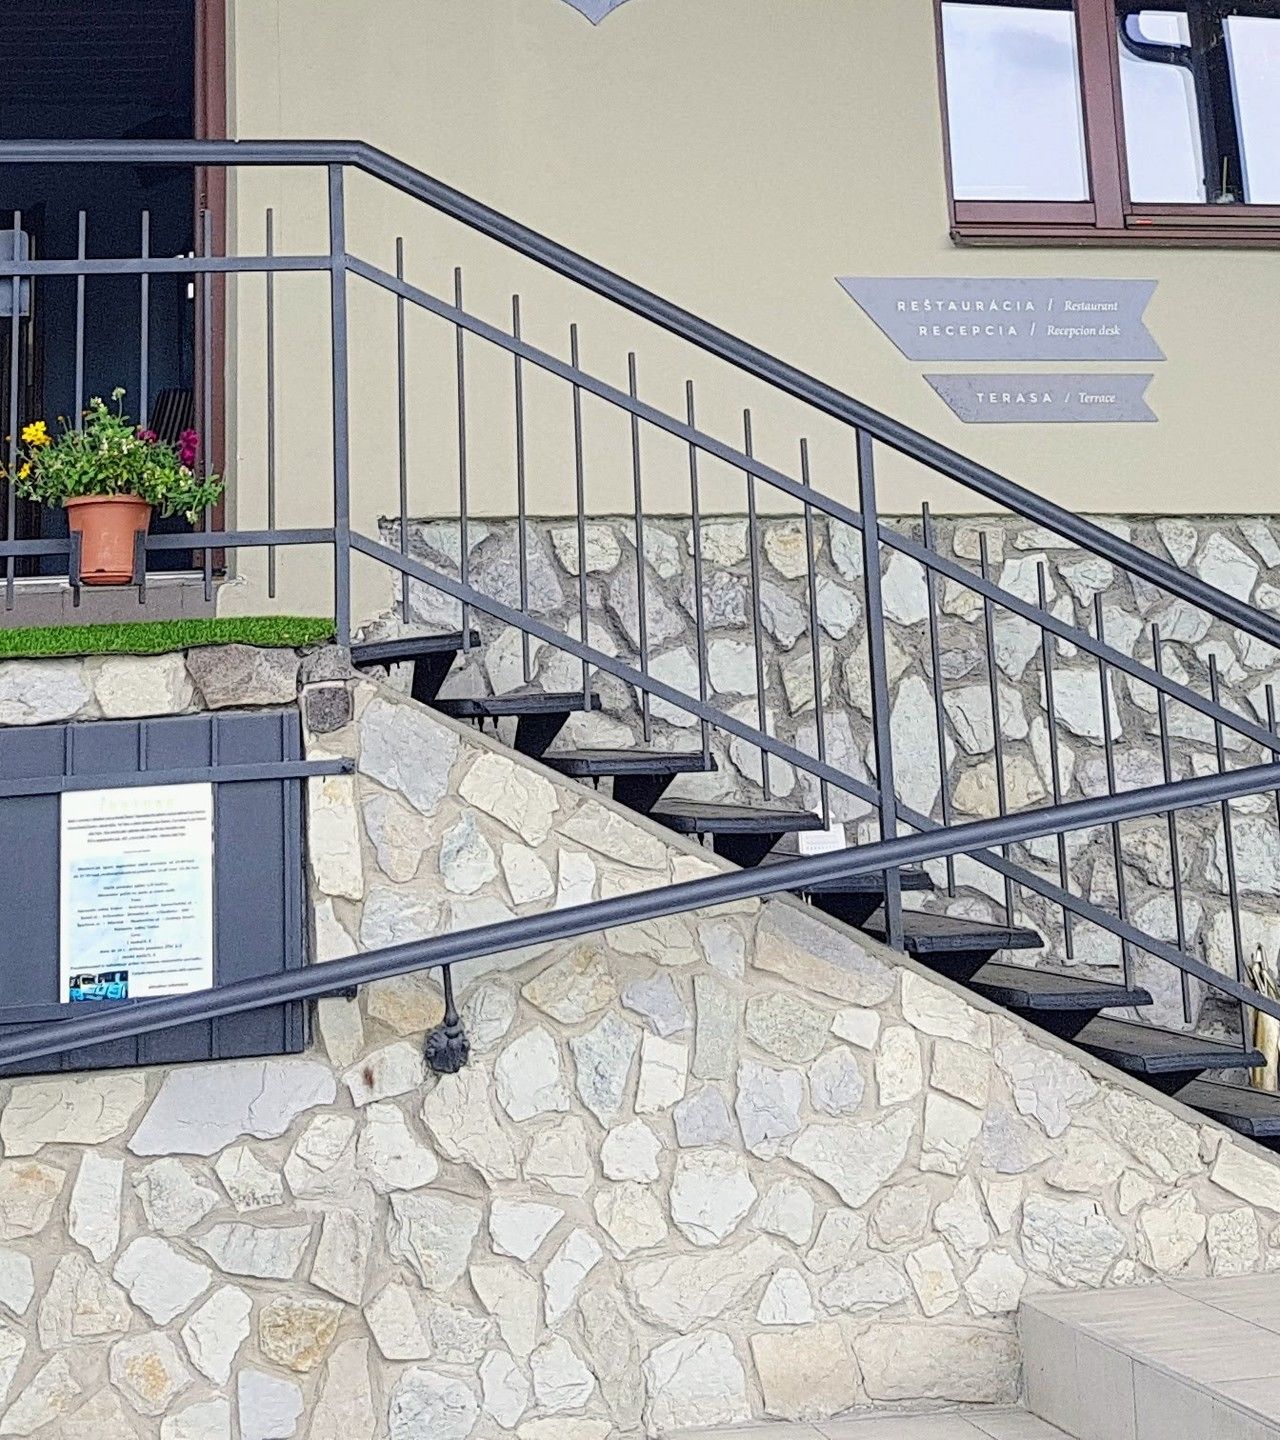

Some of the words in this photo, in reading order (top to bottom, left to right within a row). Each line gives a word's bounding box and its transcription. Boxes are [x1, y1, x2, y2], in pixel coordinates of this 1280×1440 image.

[1064, 300, 1118, 311] Restaurant
[919, 326, 1018, 336] RECEPCIA
[1098, 324, 1121, 336] desk
[976, 392, 1052, 403] TERASA
[1079, 392, 1116, 403] Terrace
